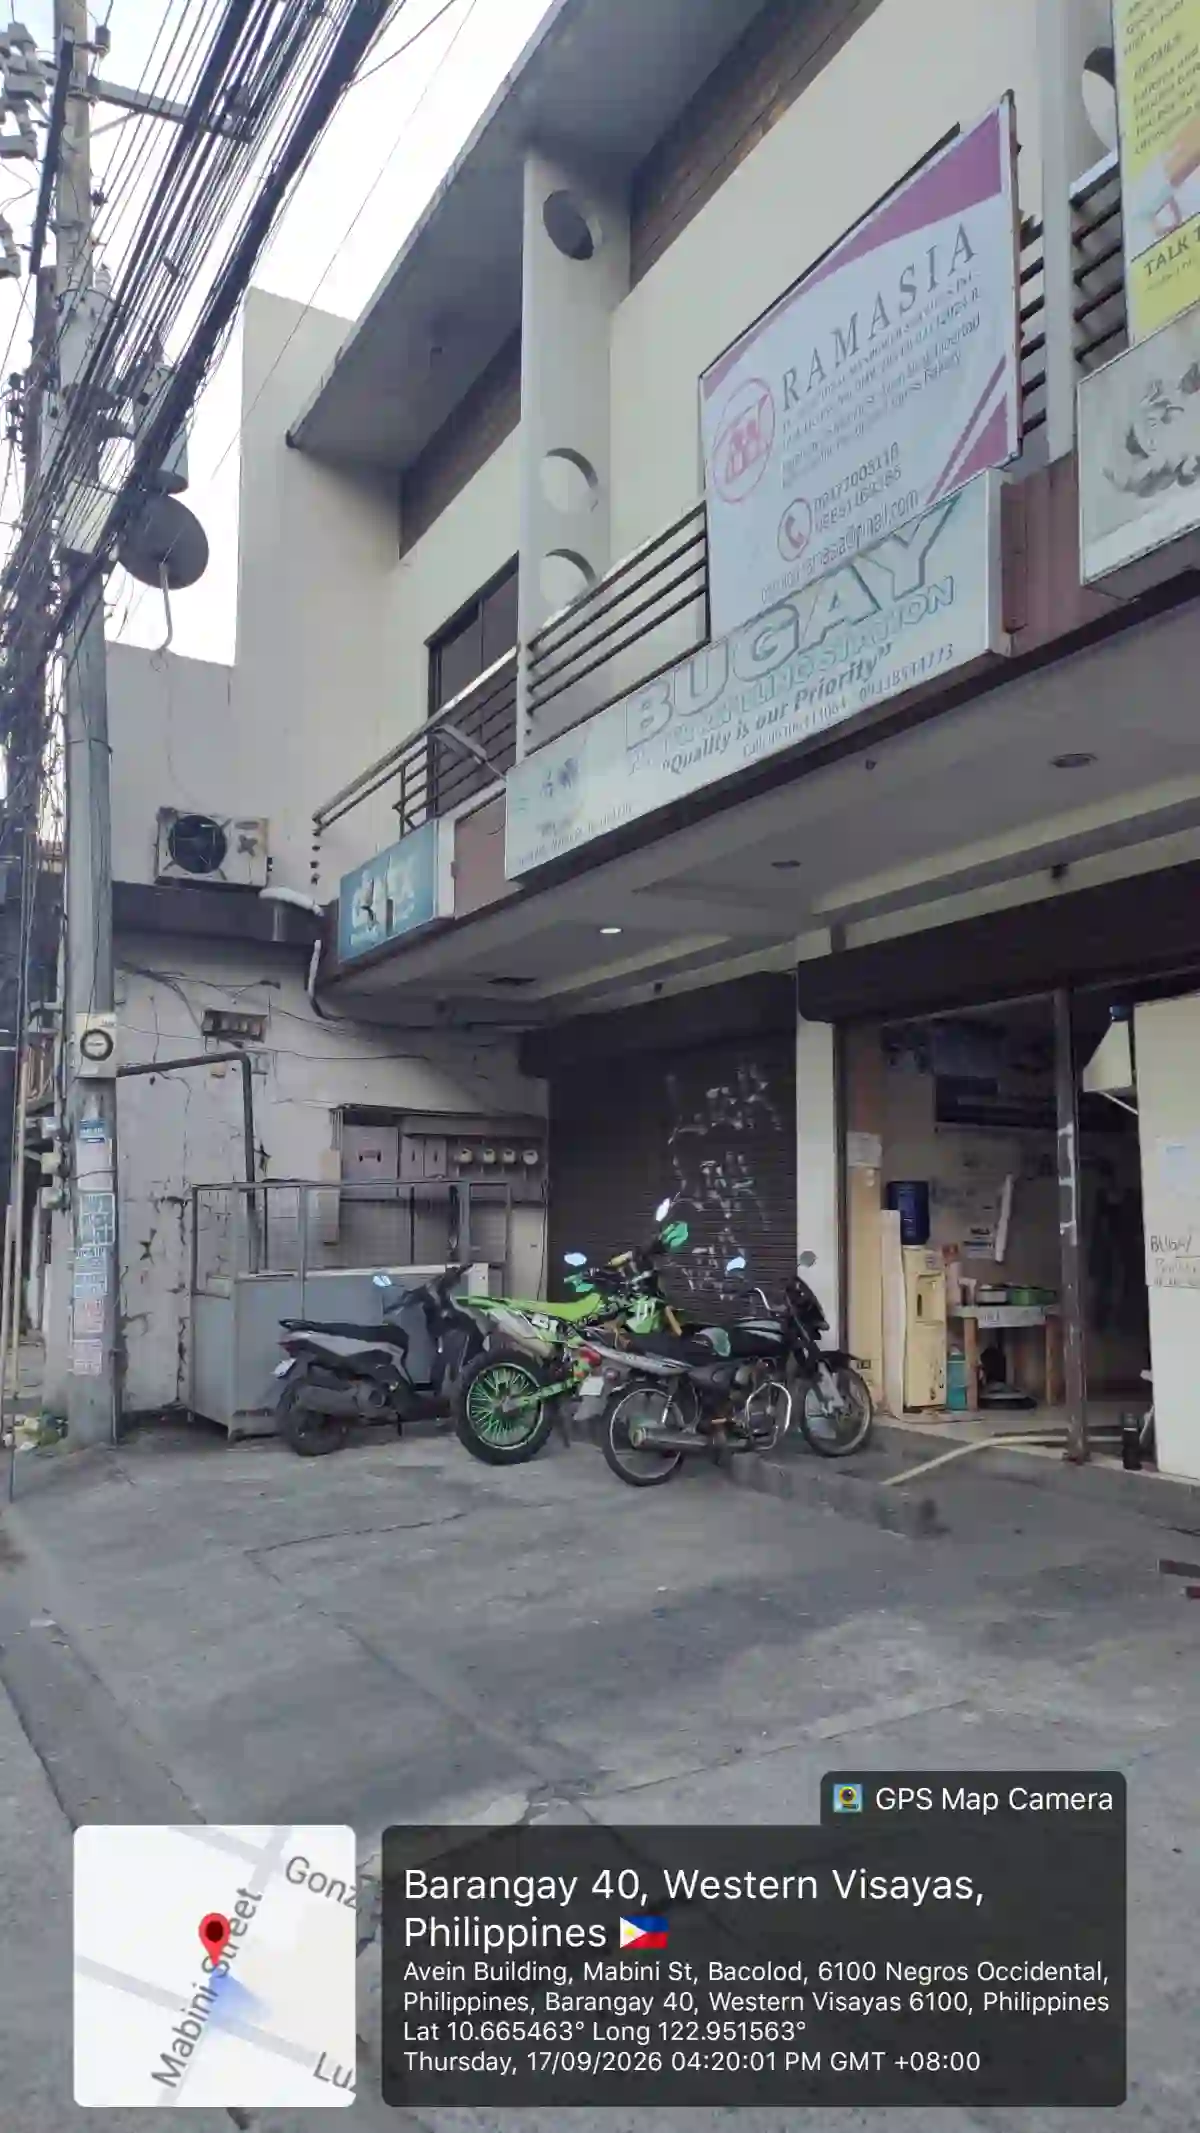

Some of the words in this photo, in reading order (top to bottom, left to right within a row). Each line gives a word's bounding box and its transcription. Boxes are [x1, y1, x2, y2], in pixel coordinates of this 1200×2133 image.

[1143, 234, 1190, 277] TALK
[781, 223, 979, 412] RAMASIA
[624, 492, 962, 751] BUGAY
[736, 720, 750, 740] is
[755, 702, 789, 730] our
